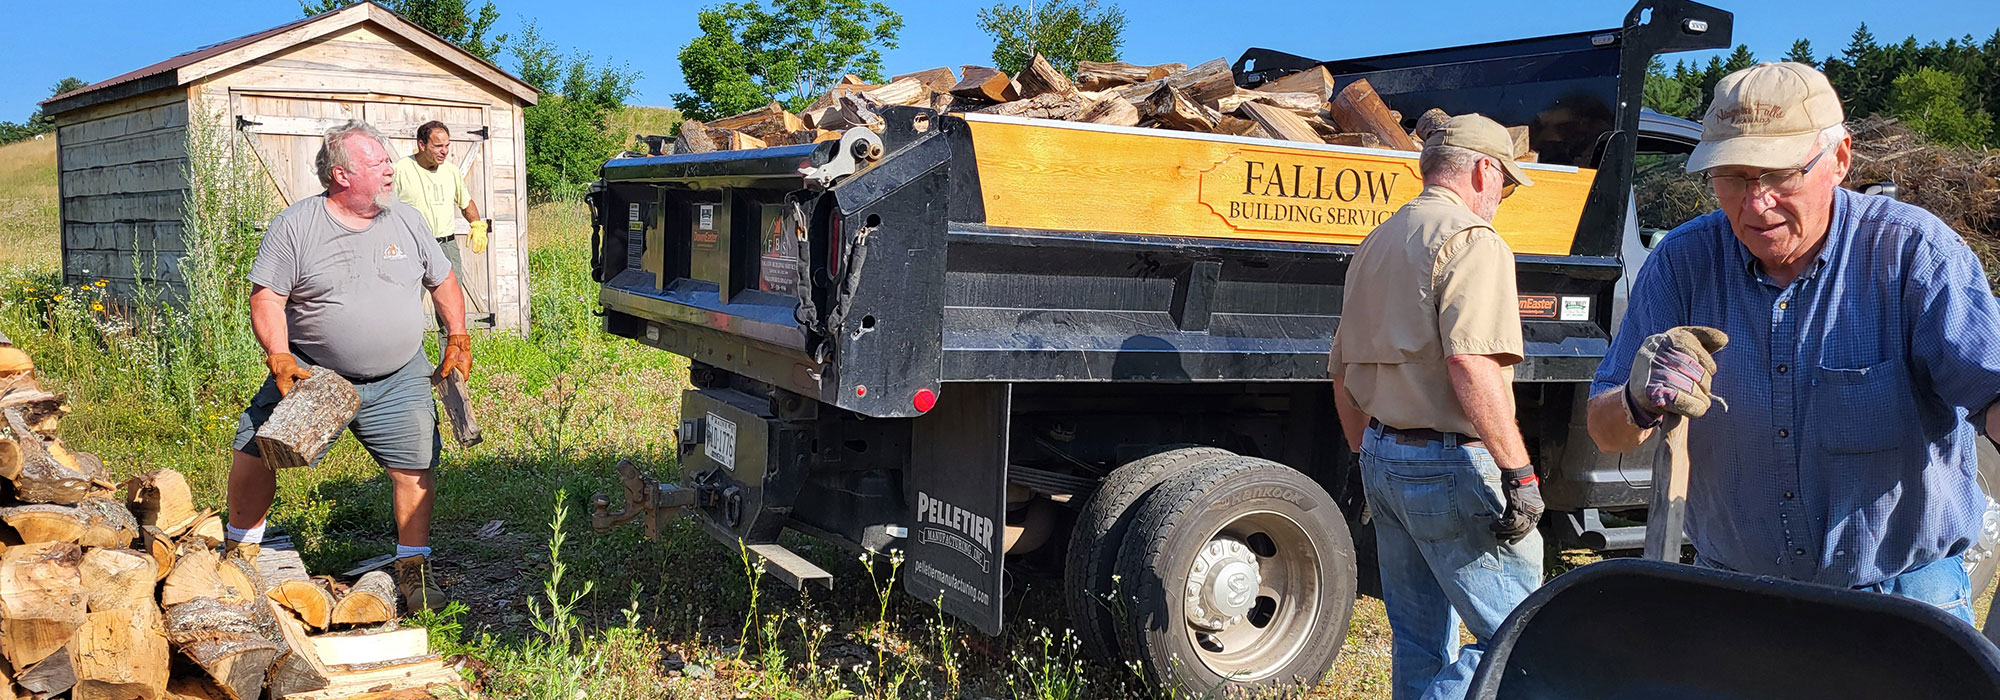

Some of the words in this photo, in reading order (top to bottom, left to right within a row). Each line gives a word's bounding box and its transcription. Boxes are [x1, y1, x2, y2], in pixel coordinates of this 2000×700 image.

[1754, 101, 1785, 119] Falls
[1242, 161, 1400, 205] FALLOW
[1229, 201, 1323, 224] BUILDING
[1327, 207, 1397, 227] SERVIC
[917, 491, 993, 554] PELLETIER
[914, 560, 990, 607] pelletiermanufacturing.com
